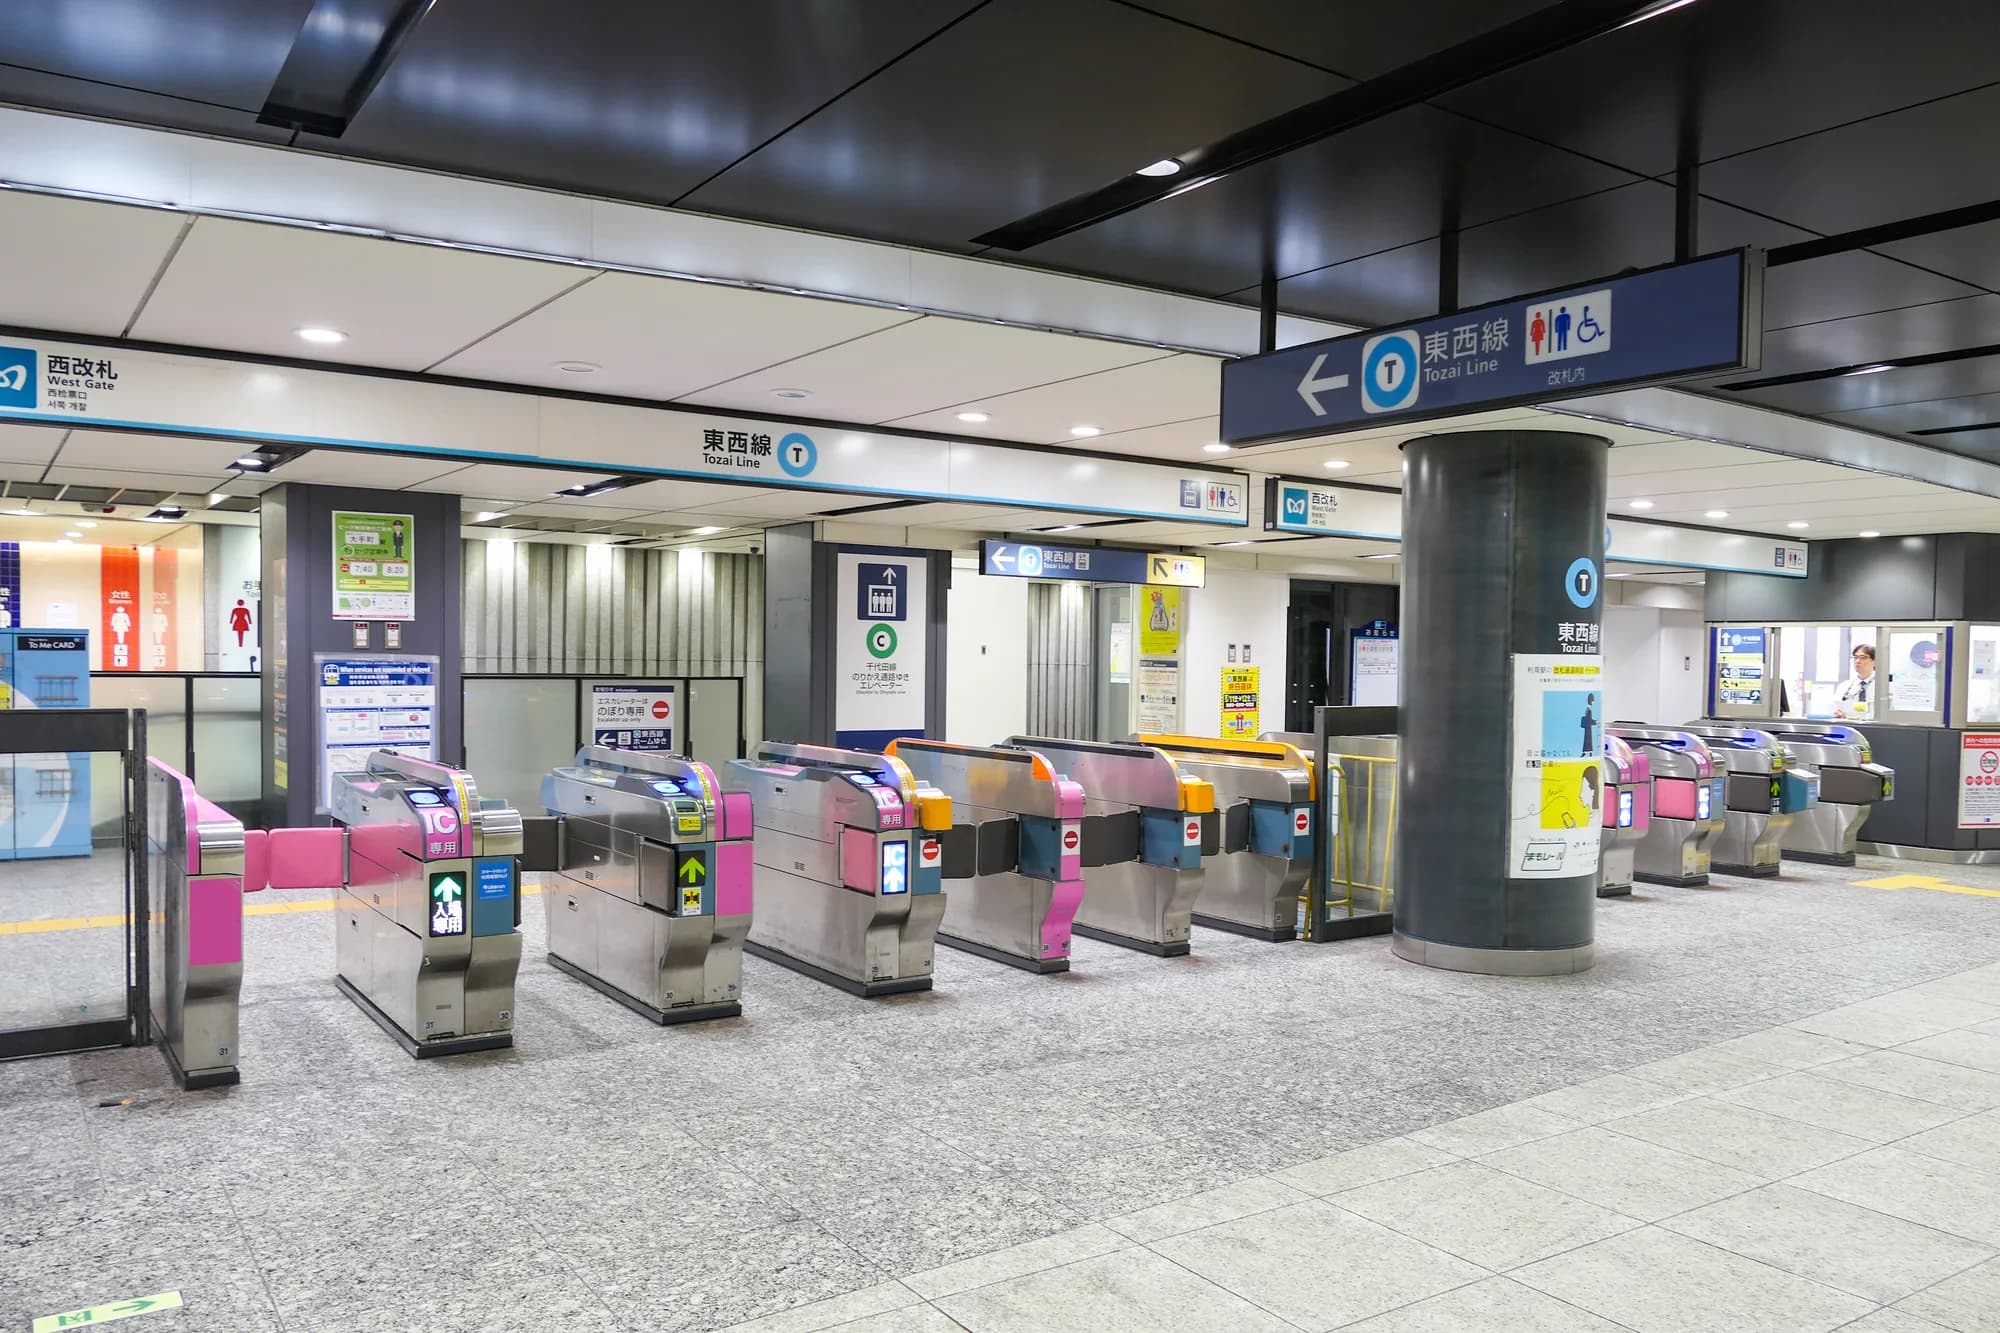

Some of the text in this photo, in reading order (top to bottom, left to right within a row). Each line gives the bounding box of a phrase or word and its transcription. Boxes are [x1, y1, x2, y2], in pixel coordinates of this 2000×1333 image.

[1423, 317, 1510, 365] 東西線
[47, 354, 118, 380] 西改札
[1384, 359, 1397, 385] T
[1423, 357, 1499, 384] Tozai Line
[47, 375, 115, 390] West Gate
[1547, 367, 1585, 386] 改札内
[702, 428, 772, 457] 東西線
[702, 452, 760, 468] Tozai Line
[792, 447, 803, 463] T
[1311, 492, 1338, 506] 西改札
[1043, 550, 1074, 564] 東西線
[1579, 574, 1589, 592] T
[1557, 622, 1599, 643] 東西線
[28, 641, 40, 649] To
[876, 635, 885, 647] C
[1561, 643, 1597, 653] Tozai Line
[866, 662, 896, 671] 千代田線
[852, 672, 910, 681] のりかえ通路ゆき
[859, 681, 902, 689] エレベーター
[597, 706, 645, 717] のぼり専用
[870, 788, 901, 808] IC
[423, 812, 457, 835] IC
[883, 814, 901, 825] 専用
[429, 841, 456, 855] 専用
[432, 917, 462, 934] 専用
[500, 1012, 510, 1020] 30
[425, 1021, 434, 1030] 31
